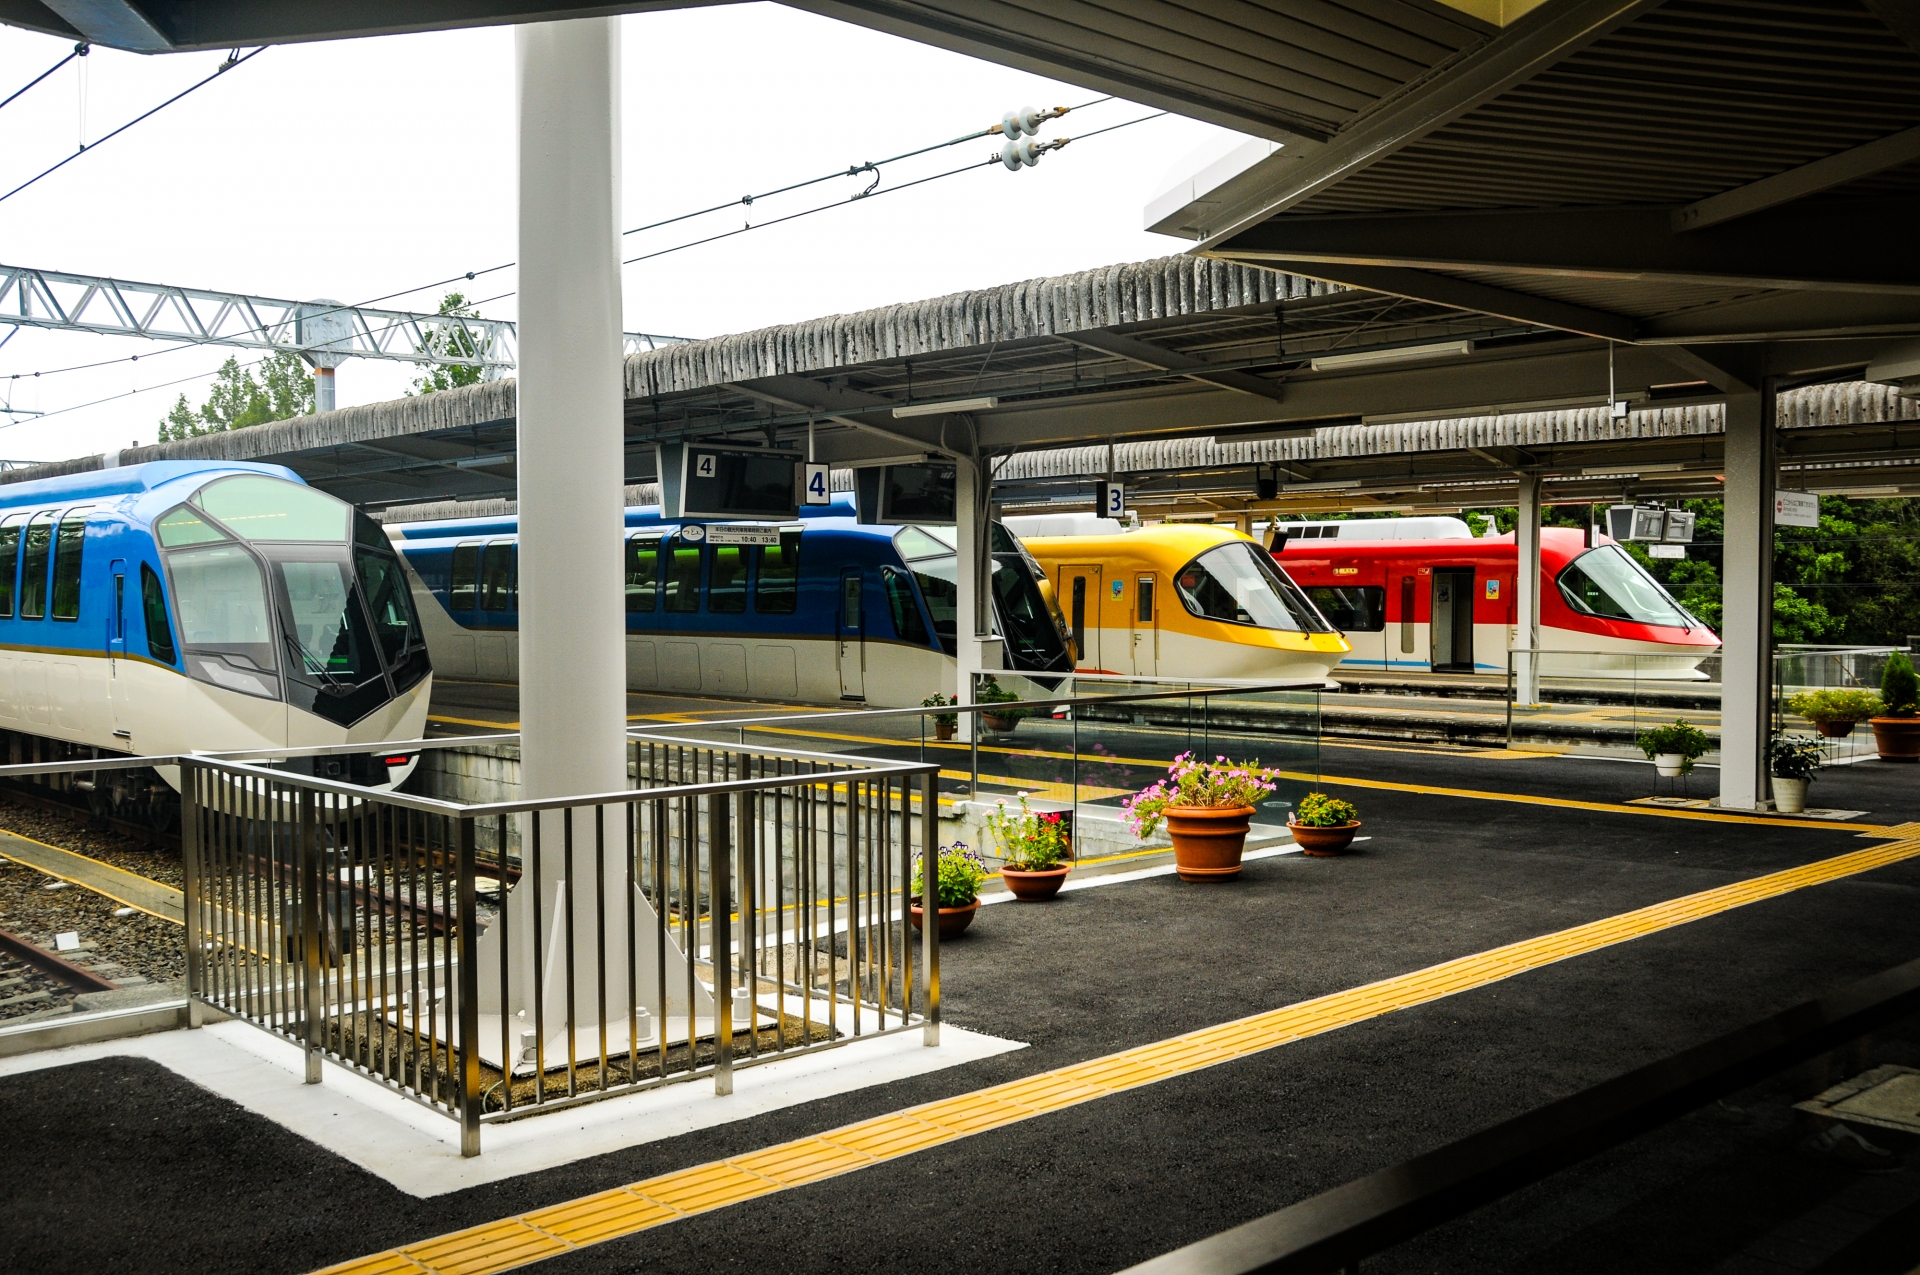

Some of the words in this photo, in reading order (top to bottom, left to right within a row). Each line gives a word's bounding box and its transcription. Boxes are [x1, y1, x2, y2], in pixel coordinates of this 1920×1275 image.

[700, 457, 712, 475] 4
[809, 472, 826, 497] 4
[1110, 489, 1122, 512] 3
